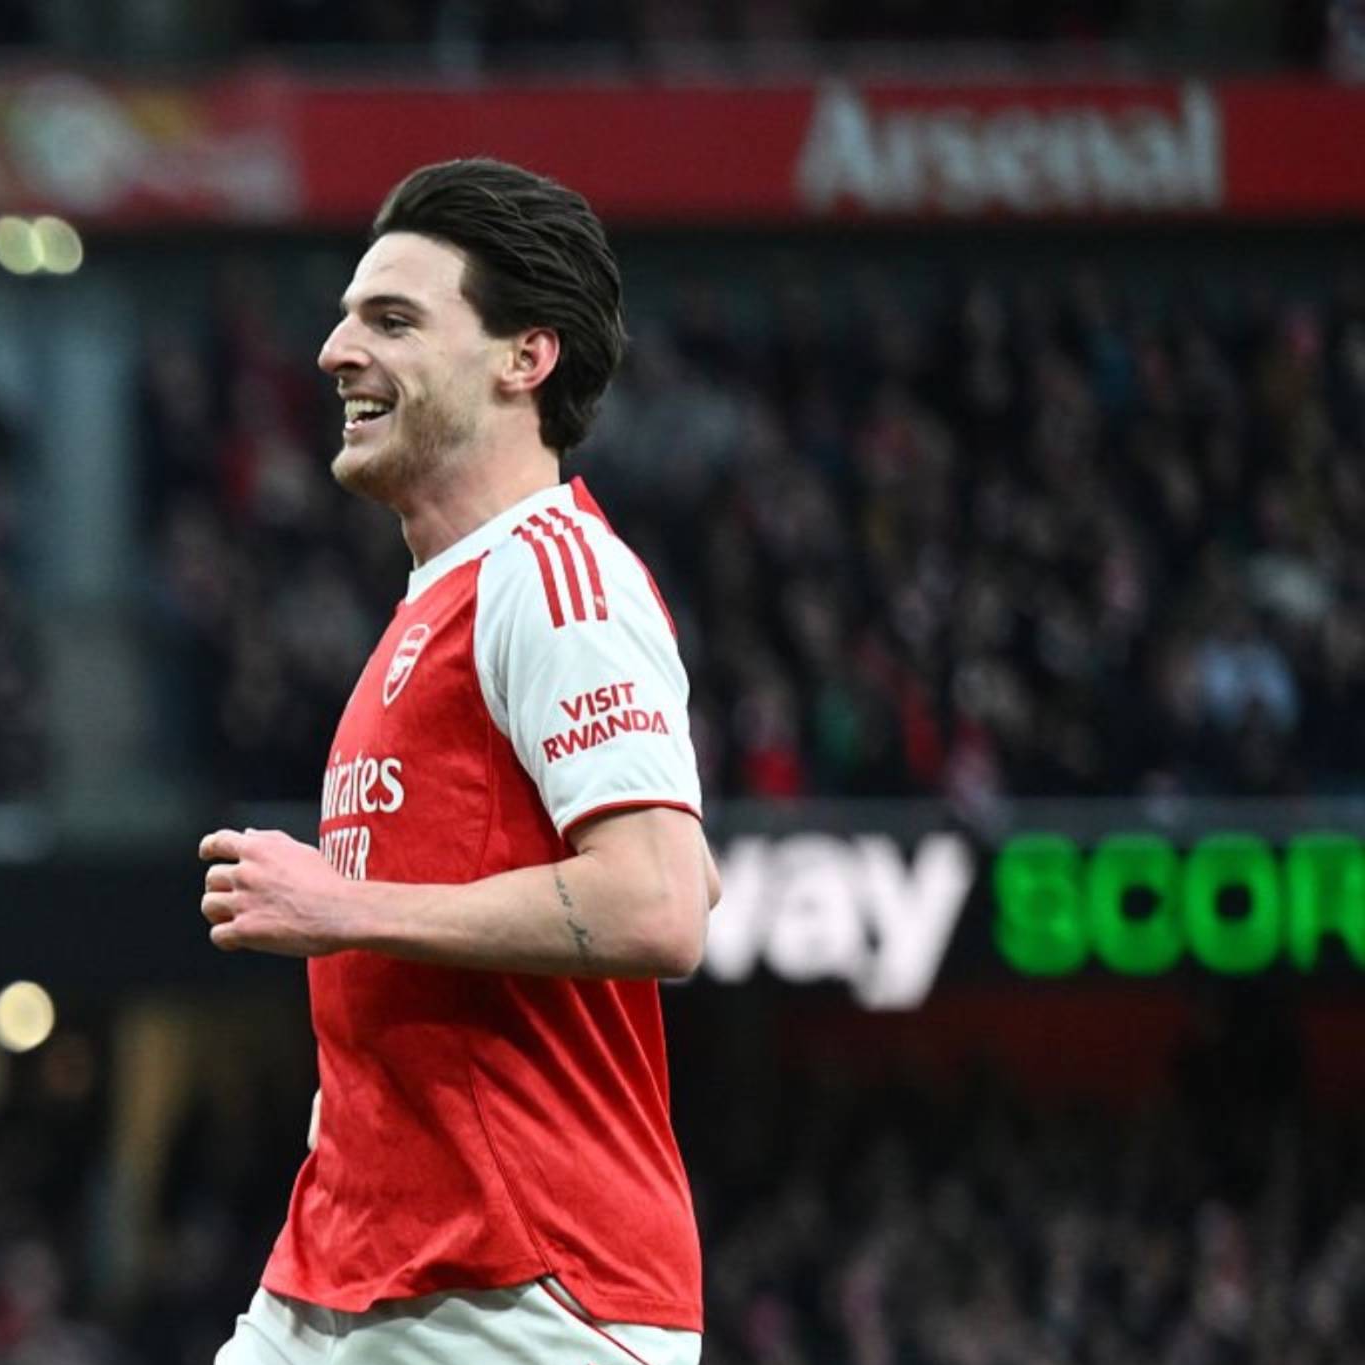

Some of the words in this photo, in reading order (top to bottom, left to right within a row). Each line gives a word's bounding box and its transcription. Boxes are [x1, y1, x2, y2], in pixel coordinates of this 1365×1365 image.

[799, 80, 1222, 208] Arsenal
[559, 681, 635, 722] VISIT
[542, 709, 669, 764] RWANDA
